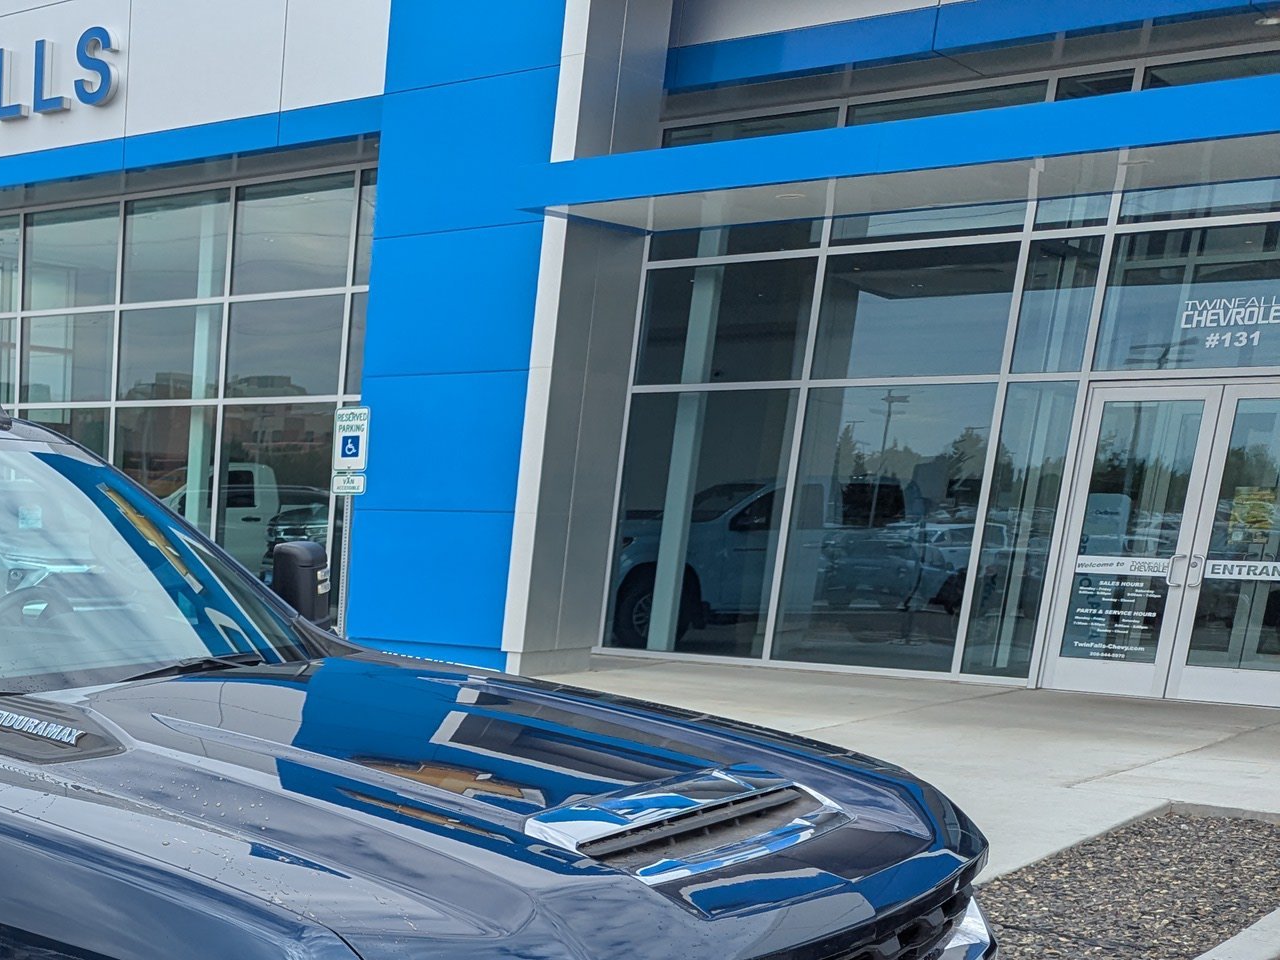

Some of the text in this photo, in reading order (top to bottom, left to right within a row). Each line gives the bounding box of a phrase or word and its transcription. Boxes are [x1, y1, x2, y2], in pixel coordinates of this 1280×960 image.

[1181, 306, 1280, 328] CHEVROLE
[1205, 330, 1260, 348] #131
[336, 412, 367, 422] RESERVED
[338, 424, 365, 433] PARKING
[1077, 561, 1114, 569] Welcome
[1073, 641, 1145, 652] TwinFalls-Chevy.com
[3, 712, 86, 746] DURAMAX
